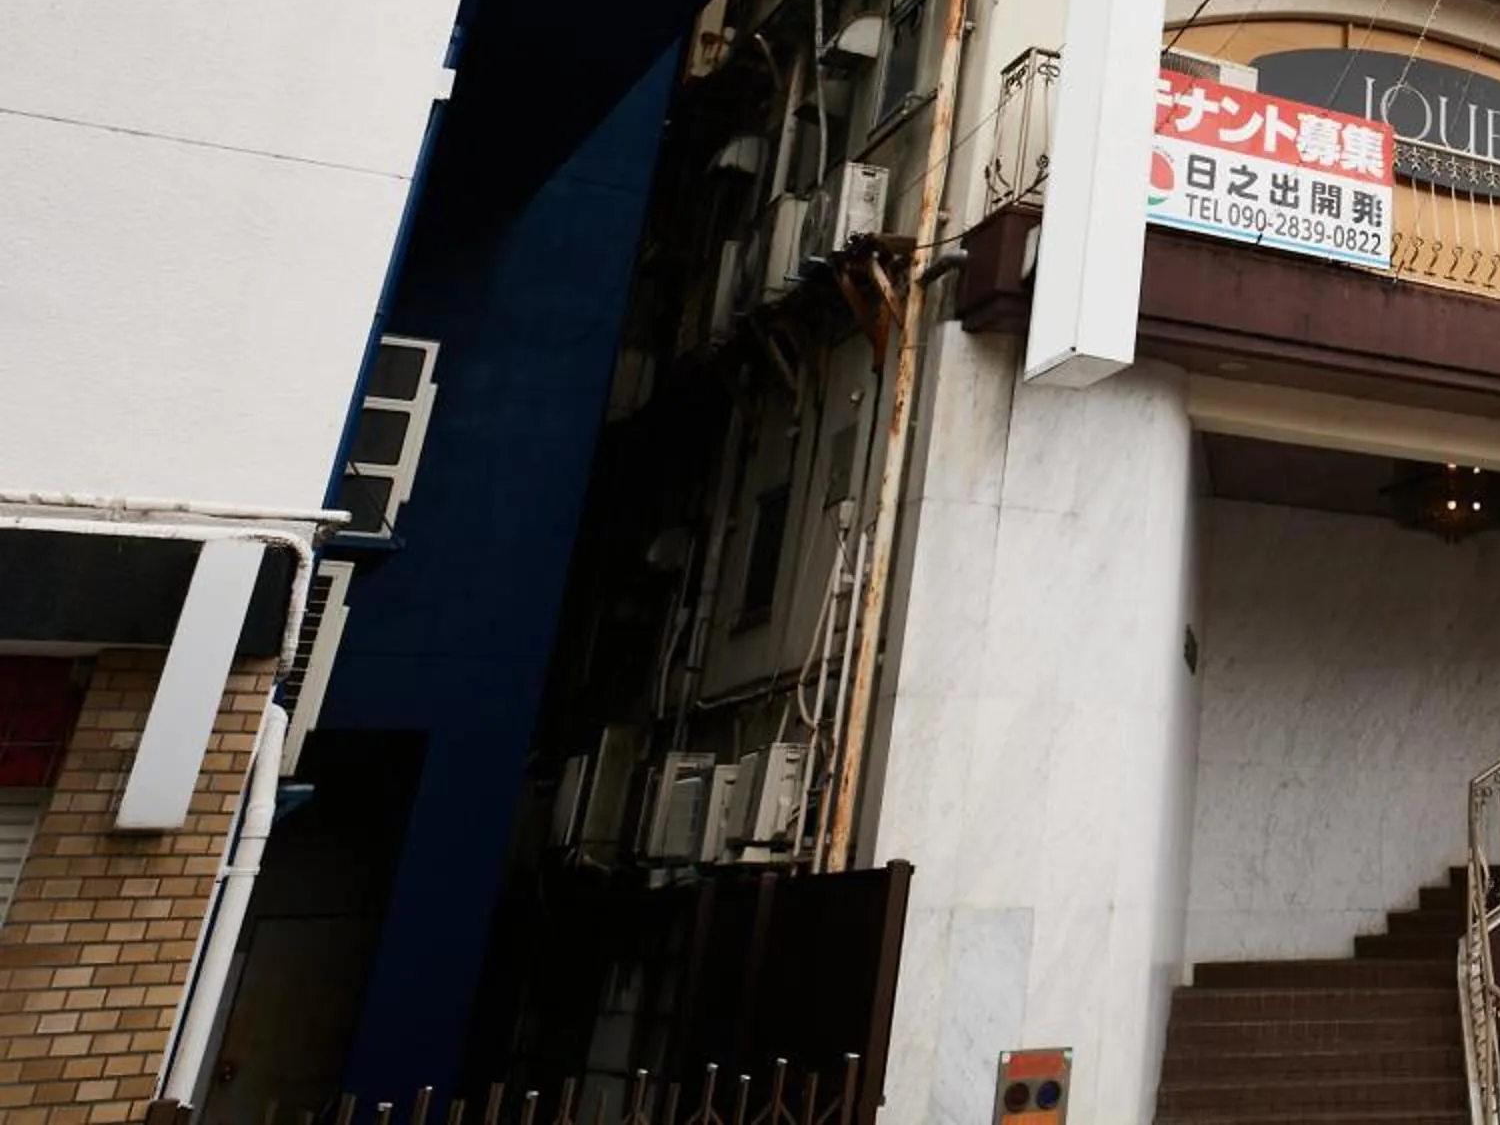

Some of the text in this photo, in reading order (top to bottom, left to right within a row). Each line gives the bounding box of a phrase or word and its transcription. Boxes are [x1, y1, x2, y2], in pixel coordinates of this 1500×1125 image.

[1186, 193, 1383, 256] TEL 090-2839-0822
[1187, 154, 1384, 229] 日之出開発
